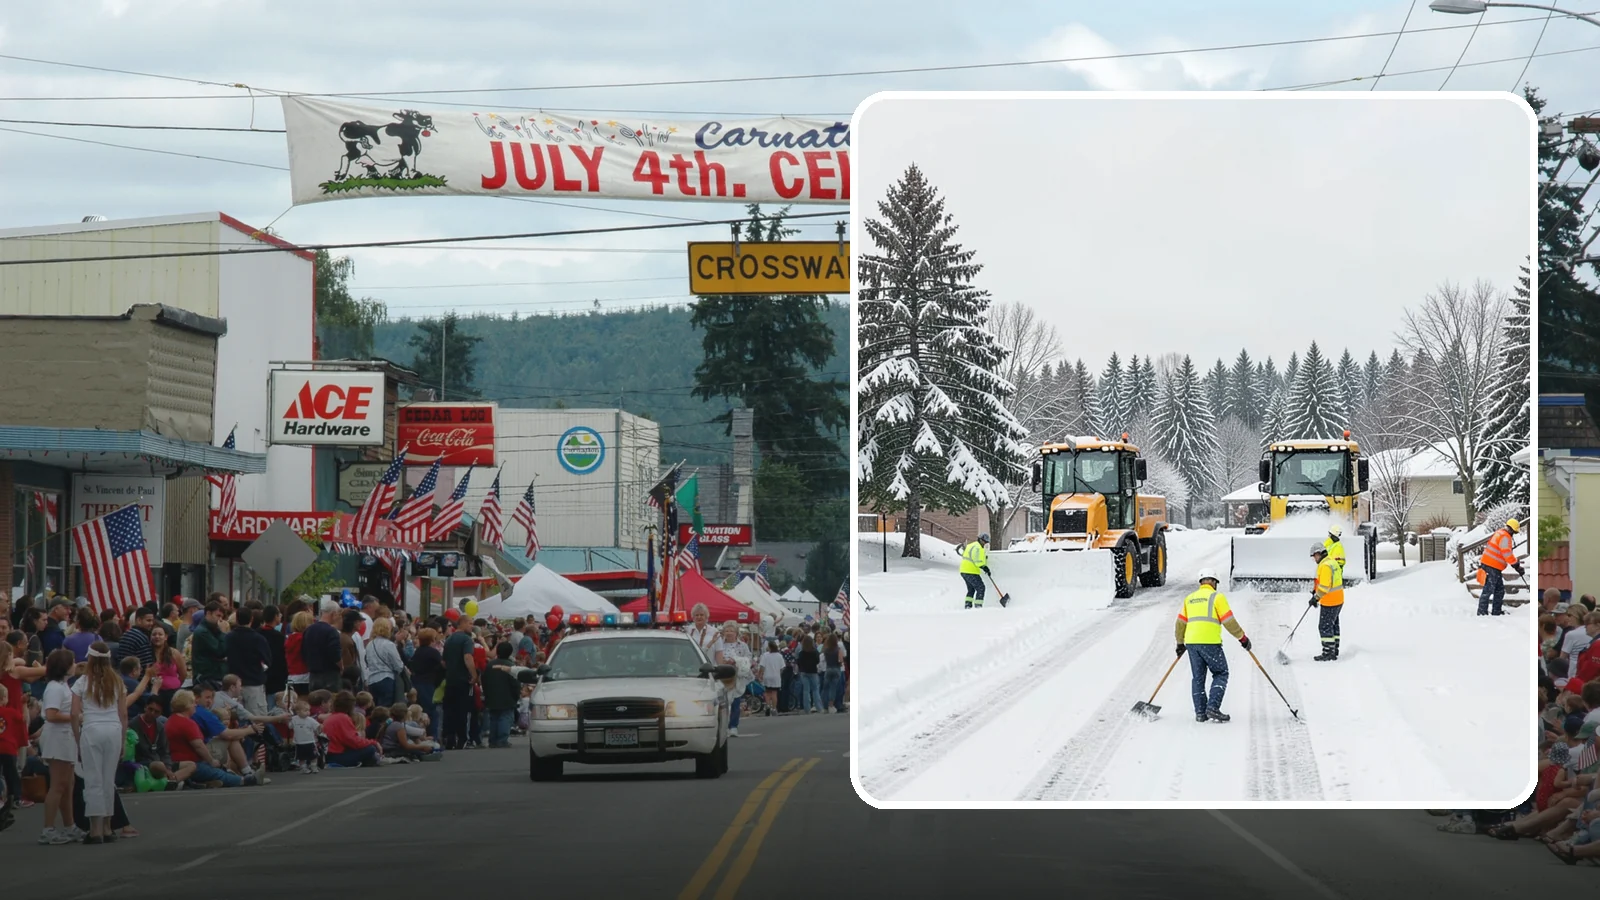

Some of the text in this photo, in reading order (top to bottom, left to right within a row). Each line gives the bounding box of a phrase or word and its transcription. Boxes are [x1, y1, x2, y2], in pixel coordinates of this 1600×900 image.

[695, 121, 850, 150] Carnat
[481, 141, 605, 192] JULY
[632, 150, 746, 197] 4th.
[697, 254, 850, 280] CROSSWA
[283, 380, 373, 420] ACE
[405, 409, 485, 422] CEDAR LOG
[283, 421, 371, 436] Hardware
[353, 467, 384, 480] Simpl
[96, 485, 124, 494] Vincent
[126, 485, 136, 494] de
[138, 486, 155, 495] Paul
[213, 516, 331, 535] HARDARE
[688, 526, 741, 535] CRNATION
[699, 535, 730, 543] GLASS
